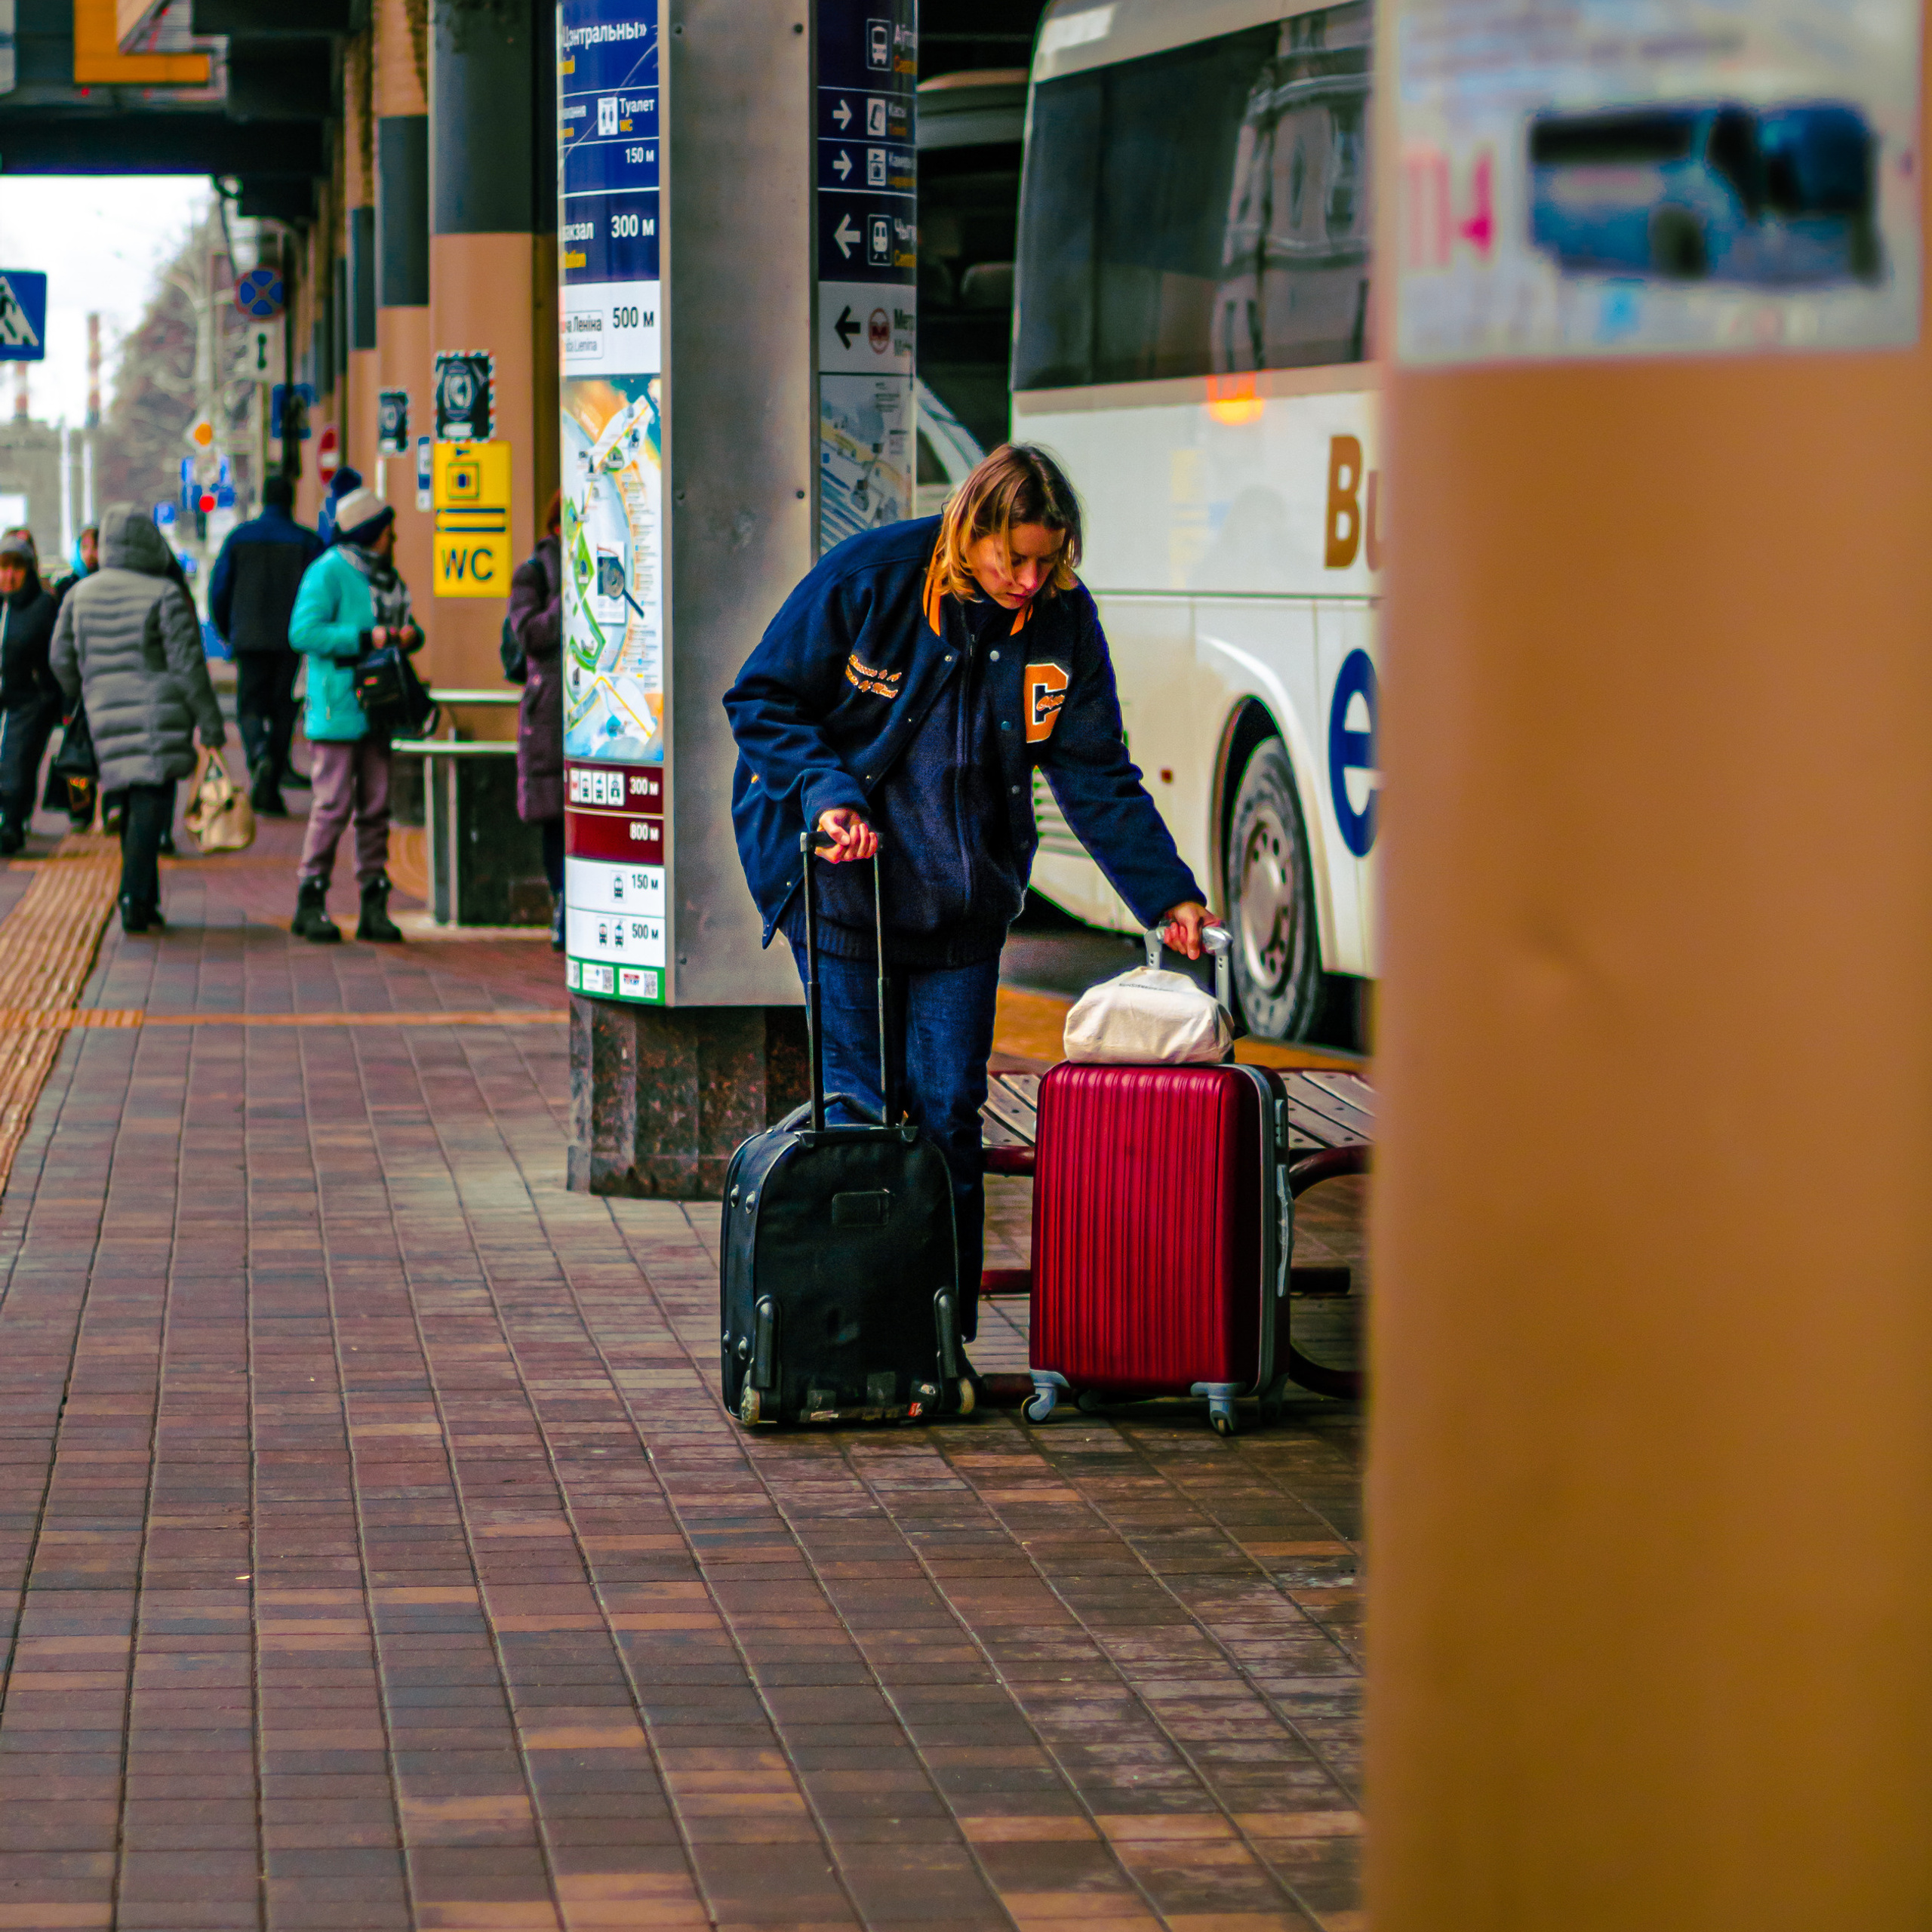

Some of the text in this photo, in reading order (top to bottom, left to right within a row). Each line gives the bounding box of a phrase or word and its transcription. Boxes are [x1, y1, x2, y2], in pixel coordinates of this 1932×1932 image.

[619, 98, 655, 118] Туалет
[626, 147, 654, 164] 150 м
[611, 214, 654, 238] 300 м
[613, 306, 654, 328] 500 м
[441, 548, 494, 582] WC
[629, 776, 659, 796] 300 м
[649, 827, 660, 841] м
[632, 874, 659, 891] 150 м
[632, 922, 659, 940] 500 м
